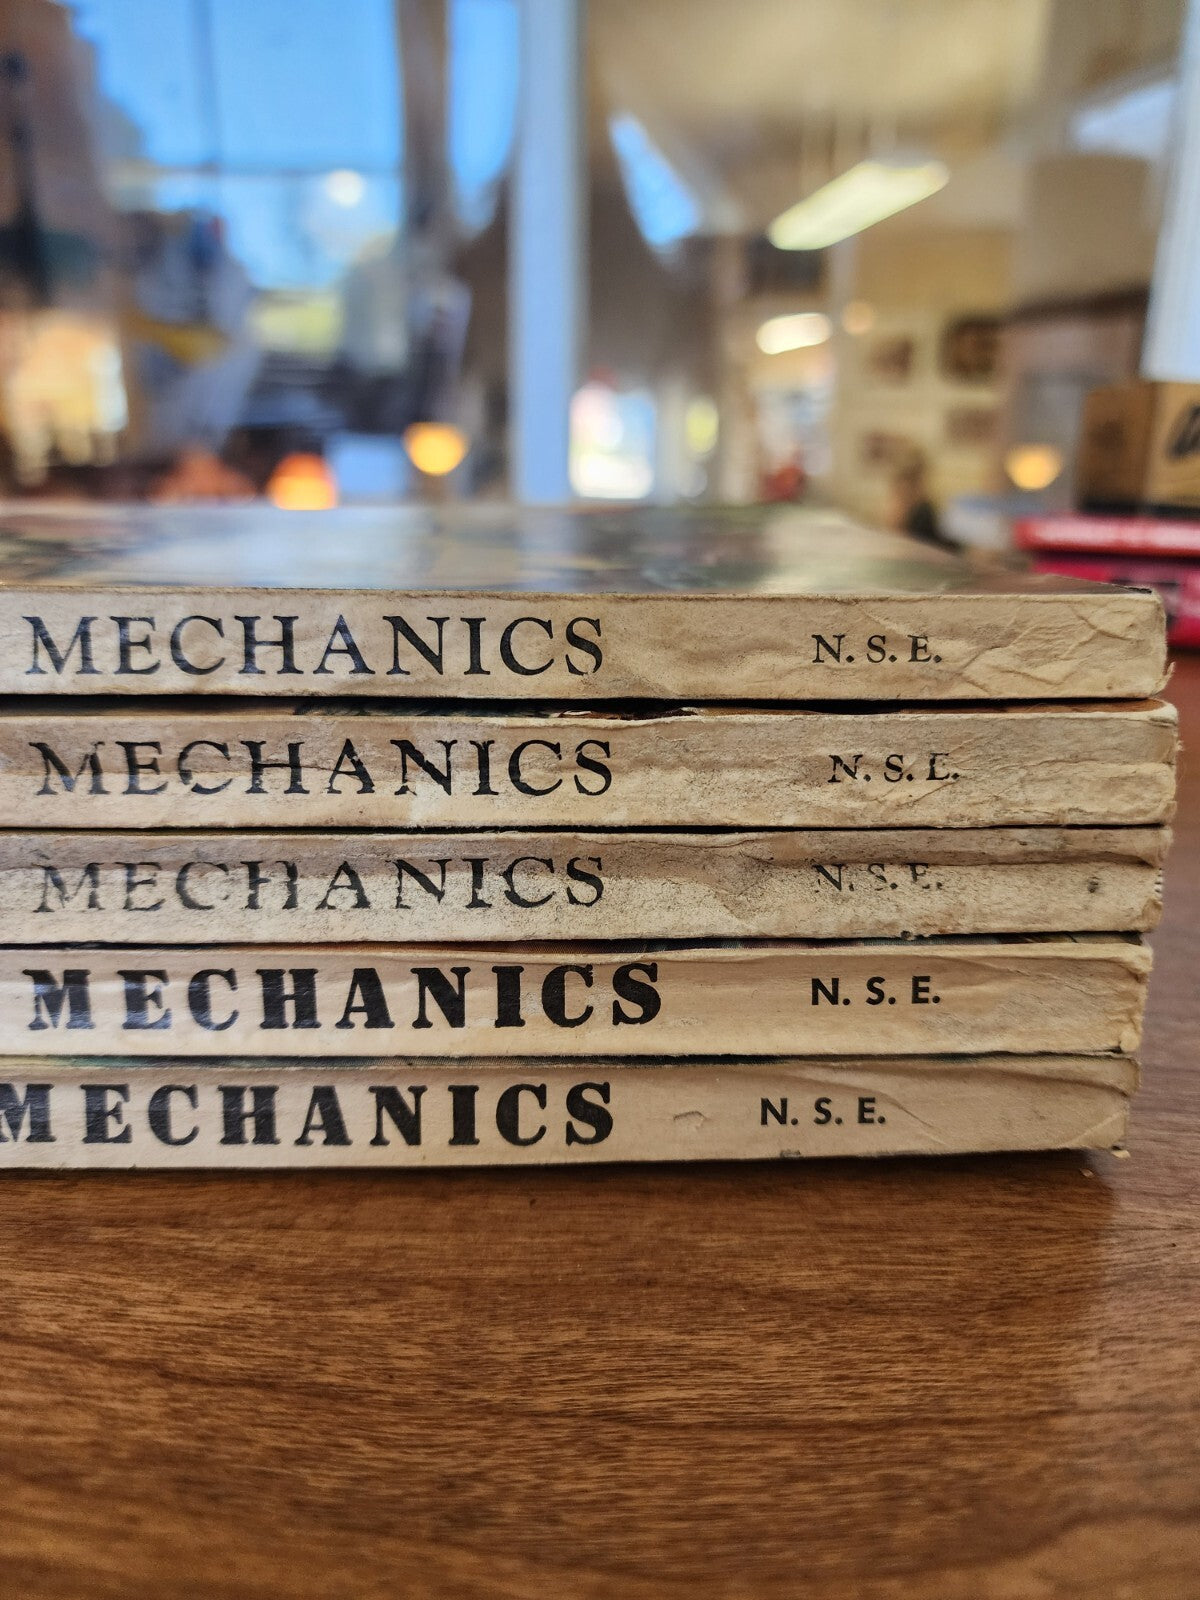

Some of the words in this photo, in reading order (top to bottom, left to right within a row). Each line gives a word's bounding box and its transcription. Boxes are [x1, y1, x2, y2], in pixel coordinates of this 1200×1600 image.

[22, 614, 604, 677] MECHANICS
[28, 738, 614, 796] MECHANICS
[31, 856, 606, 914] MECHANICS
[22, 962, 662, 1031] MECHANICS
[0, 1081, 613, 1146] MECHANICS
